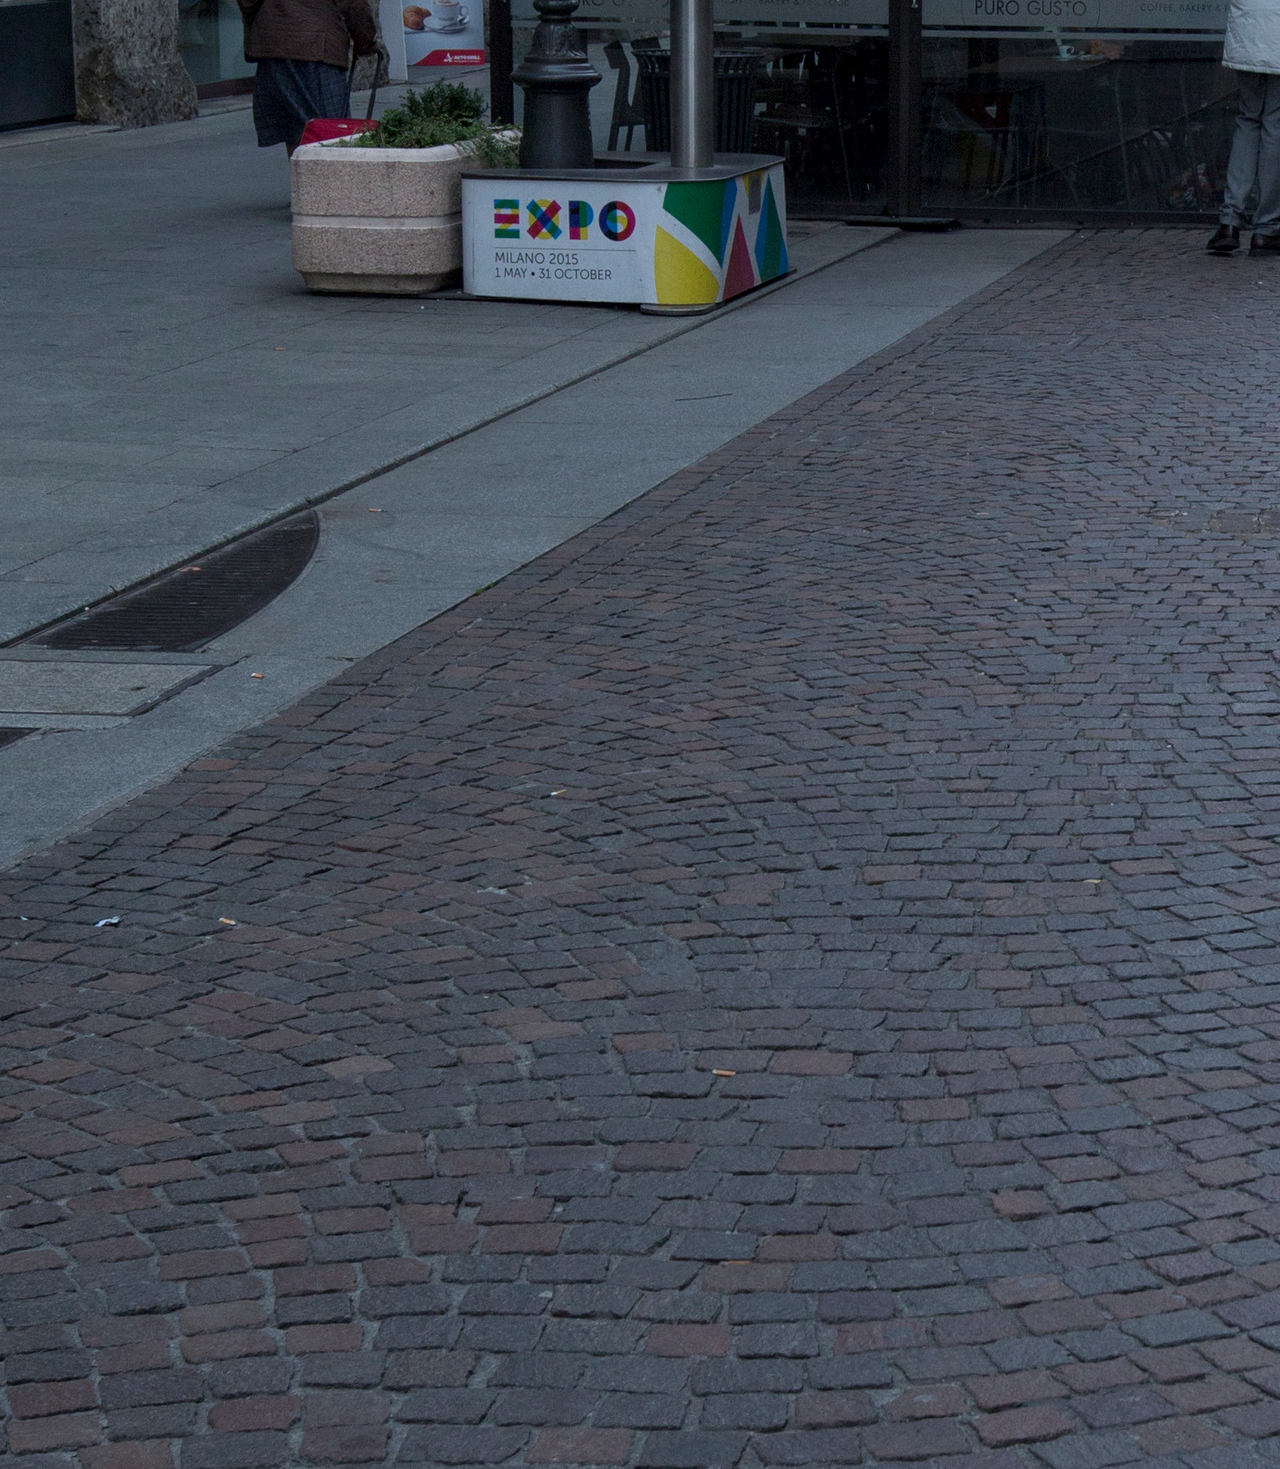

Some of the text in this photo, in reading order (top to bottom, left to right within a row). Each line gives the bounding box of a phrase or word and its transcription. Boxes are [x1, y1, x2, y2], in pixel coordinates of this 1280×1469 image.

[975, 0, 1087, 17] PURO GUSTO
[1140, 2, 1176, 13] COFFEE,
[1180, 3, 1212, 13] BAKERY
[494, 199, 636, 242] EXPO
[495, 252, 579, 265] MILANO 2015
[494, 267, 612, 281] 1 MAY 31 OCTOBER
